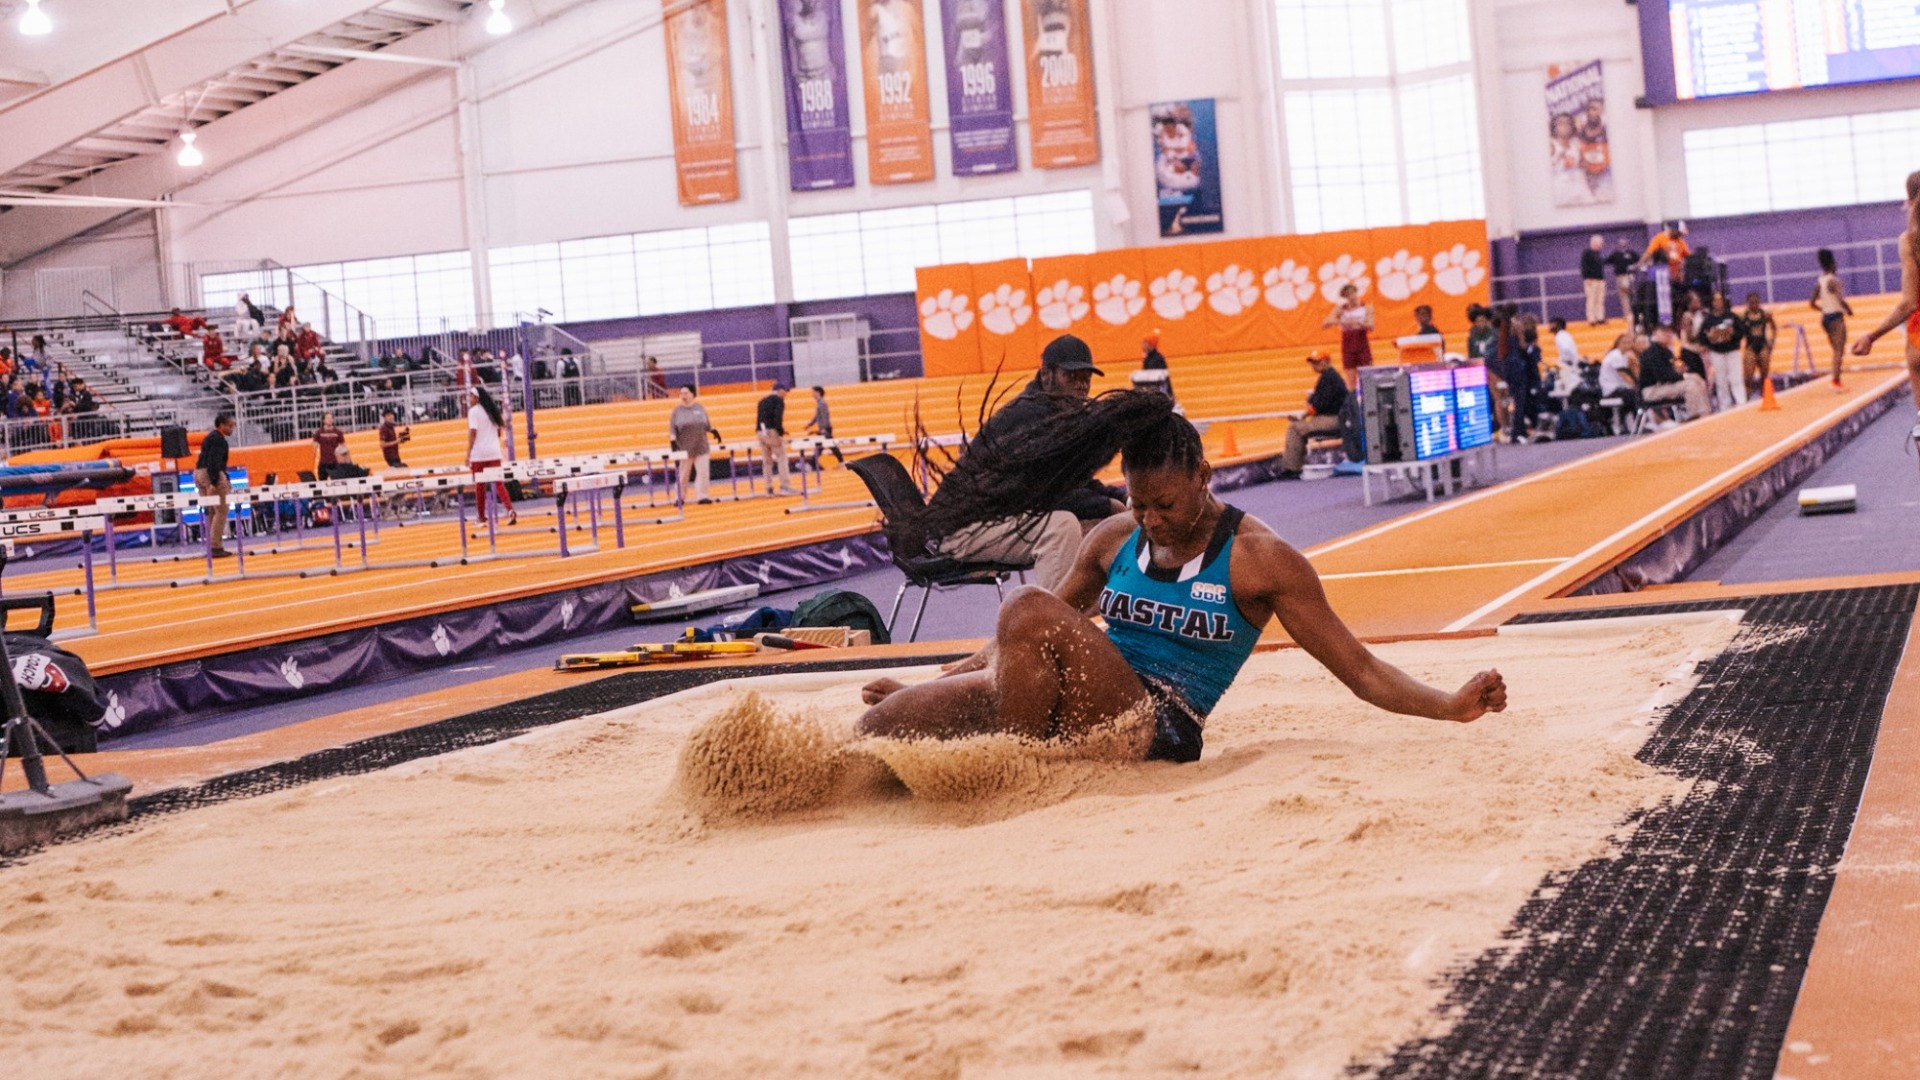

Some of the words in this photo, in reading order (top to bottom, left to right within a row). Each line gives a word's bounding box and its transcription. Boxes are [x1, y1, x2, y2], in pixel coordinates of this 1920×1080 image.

[960, 62, 996, 97] 1996
[1039, 53, 1078, 88] 2000
[799, 79, 834, 113] 1988
[877, 71, 912, 105] 1992
[686, 93, 719, 126] 1984
[527, 468, 556, 477] UCS
[325, 480, 347, 488] UCS
[396, 480, 425, 490] UCS
[273, 491, 300, 500] UCS
[147, 500, 175, 510] UCS
[28, 510, 56, 520] UCS
[2, 523, 41, 536] UCS
[1190, 581, 1227, 604] SBC
[20, 655, 41, 684] COACH
